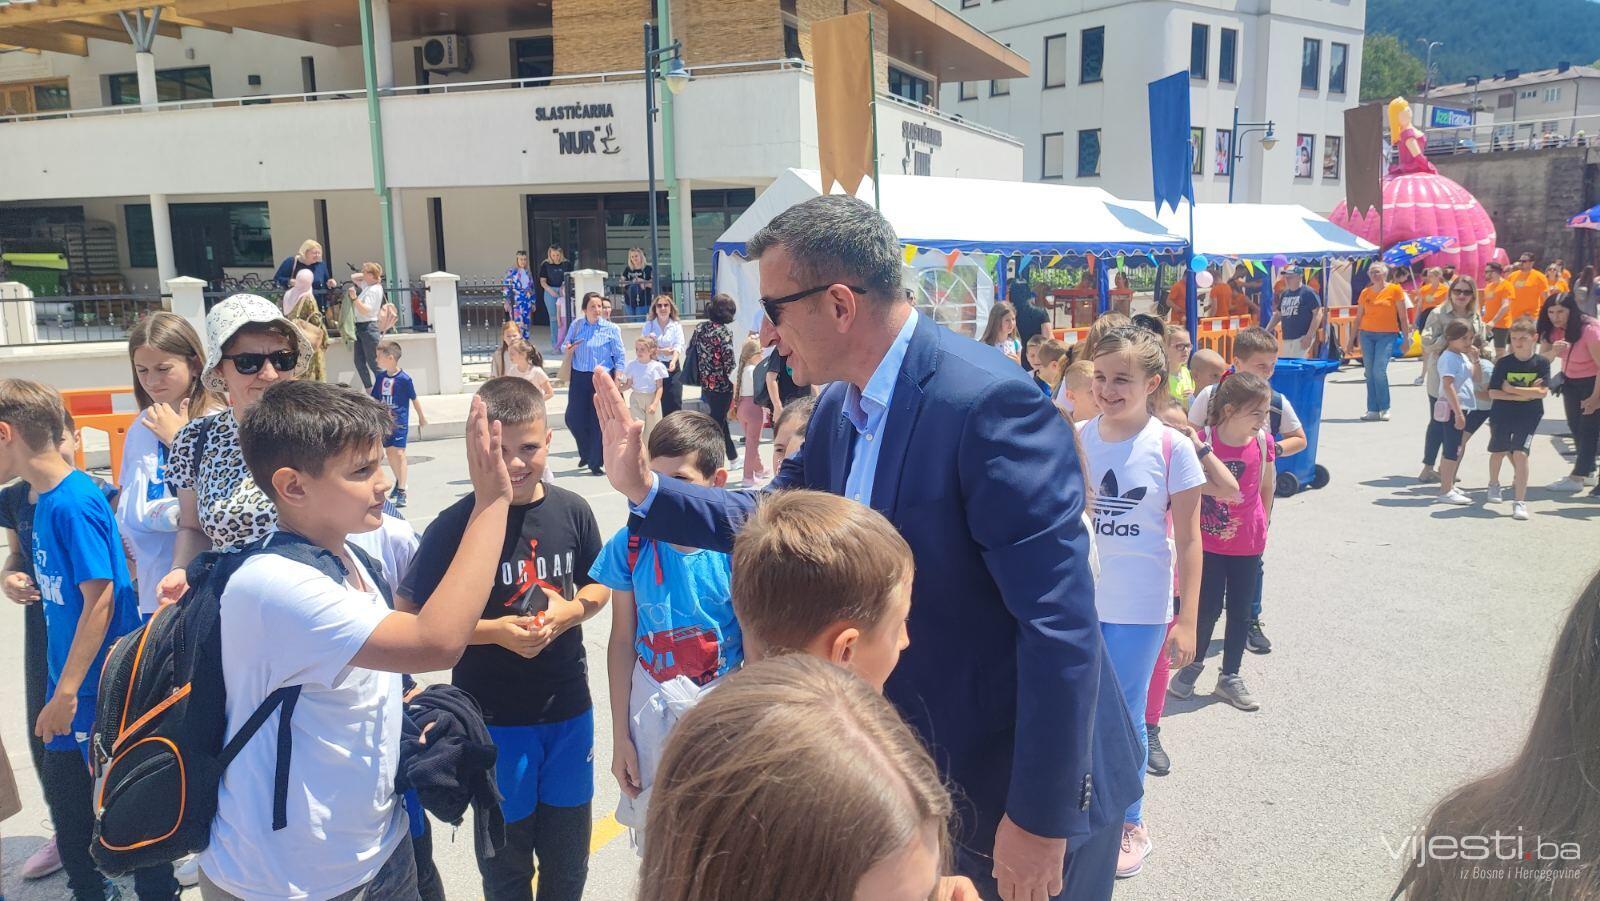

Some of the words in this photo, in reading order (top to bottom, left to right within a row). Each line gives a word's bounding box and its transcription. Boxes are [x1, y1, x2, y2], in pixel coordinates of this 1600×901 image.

[535, 101, 614, 121] SLASTIČARNA
[1093, 517, 1140, 536] idas
[501, 551, 573, 585] ORDAN
